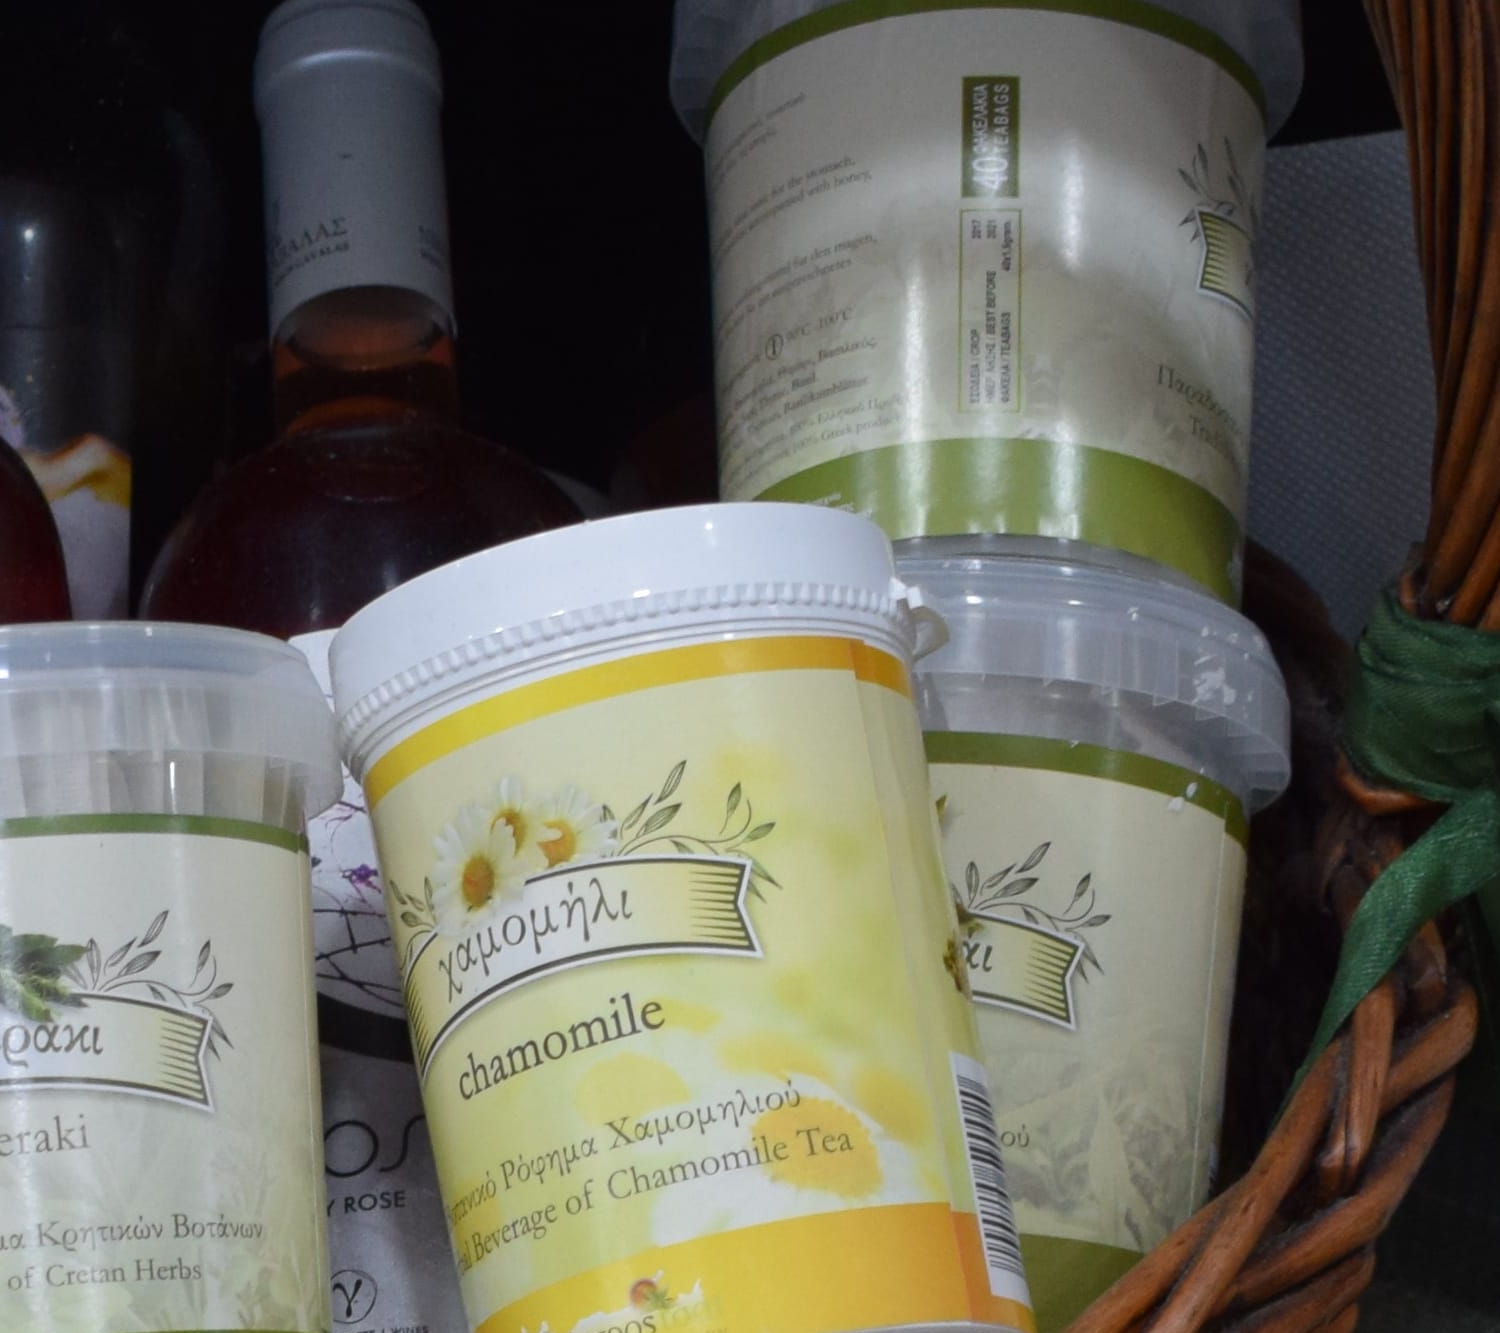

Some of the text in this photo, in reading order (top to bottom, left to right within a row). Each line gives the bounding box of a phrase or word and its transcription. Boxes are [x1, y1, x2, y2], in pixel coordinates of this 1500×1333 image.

[994, 83, 1008, 153] TEABAGS
[438, 877, 633, 1003] χαμομήλι
[458, 992, 666, 1100] chamomile
[500, 1135, 599, 1191] Ρόφημα
[603, 1080, 802, 1150] Χαμομηλιού
[36, 1214, 164, 1254] Κρητικών
[171, 1213, 264, 1240] Βοτάνων
[344, 1190, 406, 1214] ROSE
[472, 1201, 558, 1264] Beverage
[564, 1178, 594, 1216] of
[607, 1135, 789, 1201] Chamomile
[796, 1125, 854, 1157] Tea
[6, 1266, 36, 1290] of
[45, 1262, 127, 1290] Cretan
[134, 1257, 203, 1282] Herbs
